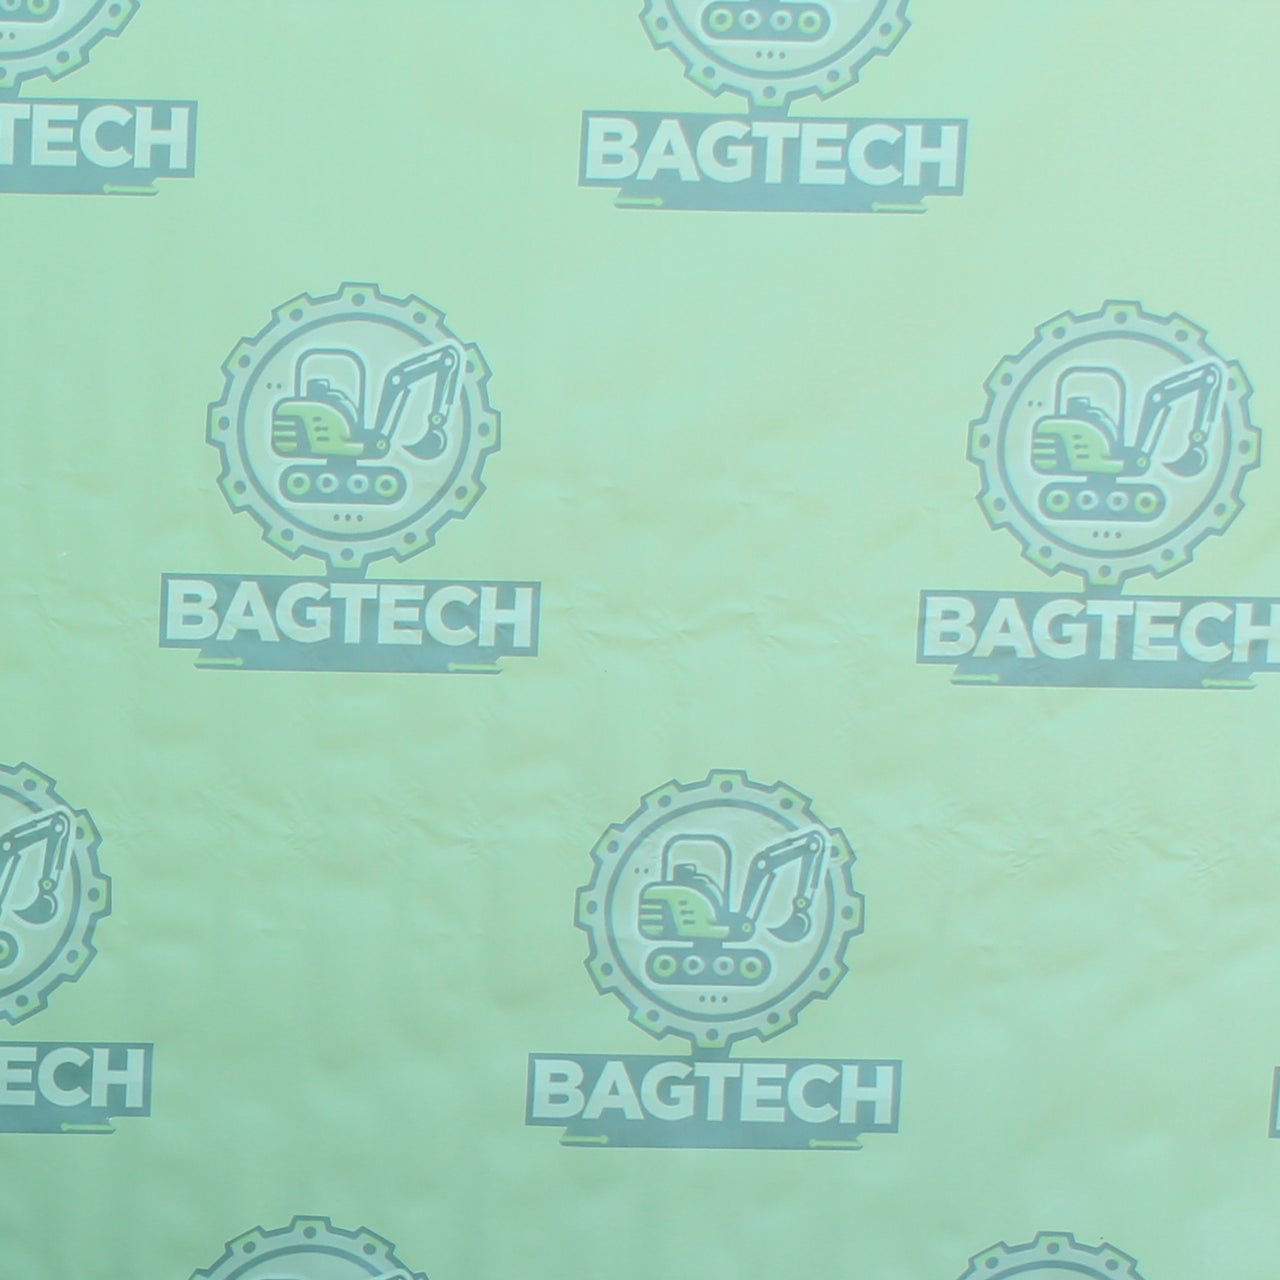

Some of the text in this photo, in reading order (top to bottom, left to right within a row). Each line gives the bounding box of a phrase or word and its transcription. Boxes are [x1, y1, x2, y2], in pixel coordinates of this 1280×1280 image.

[586, 118, 959, 187] BAGTECH
[167, 580, 536, 649] BAGTECH
[923, 596, 1280, 663] BAGTECH
[531, 1058, 893, 1124] BAGTECH
